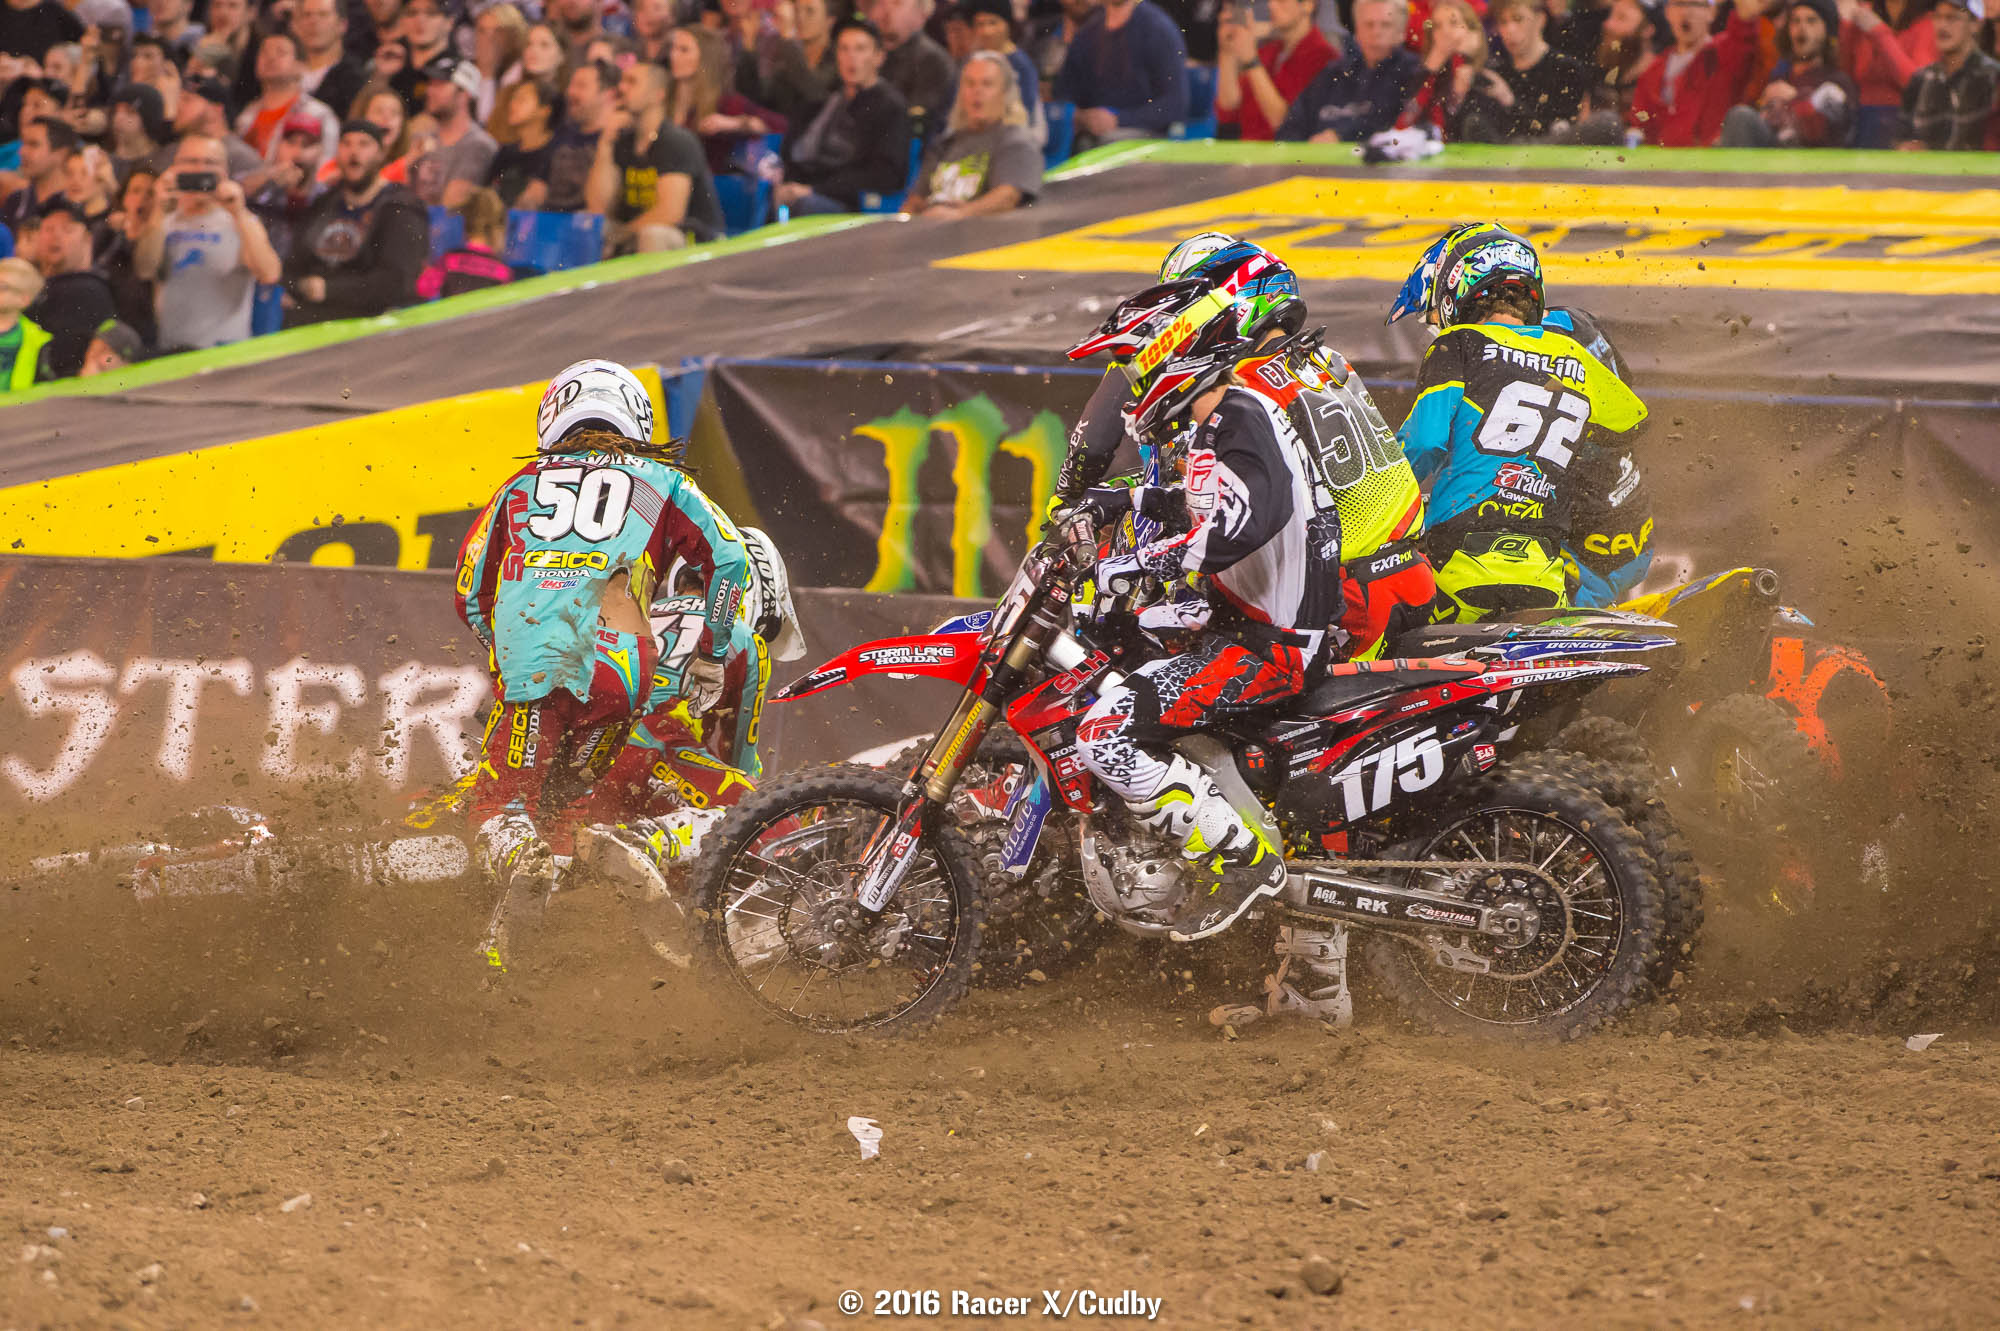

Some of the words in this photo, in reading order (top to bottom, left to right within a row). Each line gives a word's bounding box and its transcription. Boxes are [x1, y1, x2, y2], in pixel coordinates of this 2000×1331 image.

[1140, 315, 1193, 371] 100%
[1478, 380, 1591, 468] 62
[528, 466, 634, 543] 50
[524, 551, 609, 570] GEICO
[533, 569, 592, 579] HONDA
[536, 579, 579, 589] AMSOIL
[710, 577, 730, 623] HONDA
[858, 646, 911, 662] STORM
[915, 646, 954, 658] LAKE
[874, 655, 940, 666] HONDA
[1053, 648, 1111, 694] SLH
[1511, 670, 1581, 685] DUNLOP
[747, 632, 770, 745] GEICO
[1401, 699, 1429, 712] COATES
[1330, 726, 1444, 822] 175
[1312, 886, 1337, 901] A60
[1356, 896, 1390, 915] RK
[1425, 908, 1477, 923] RENTHAL
